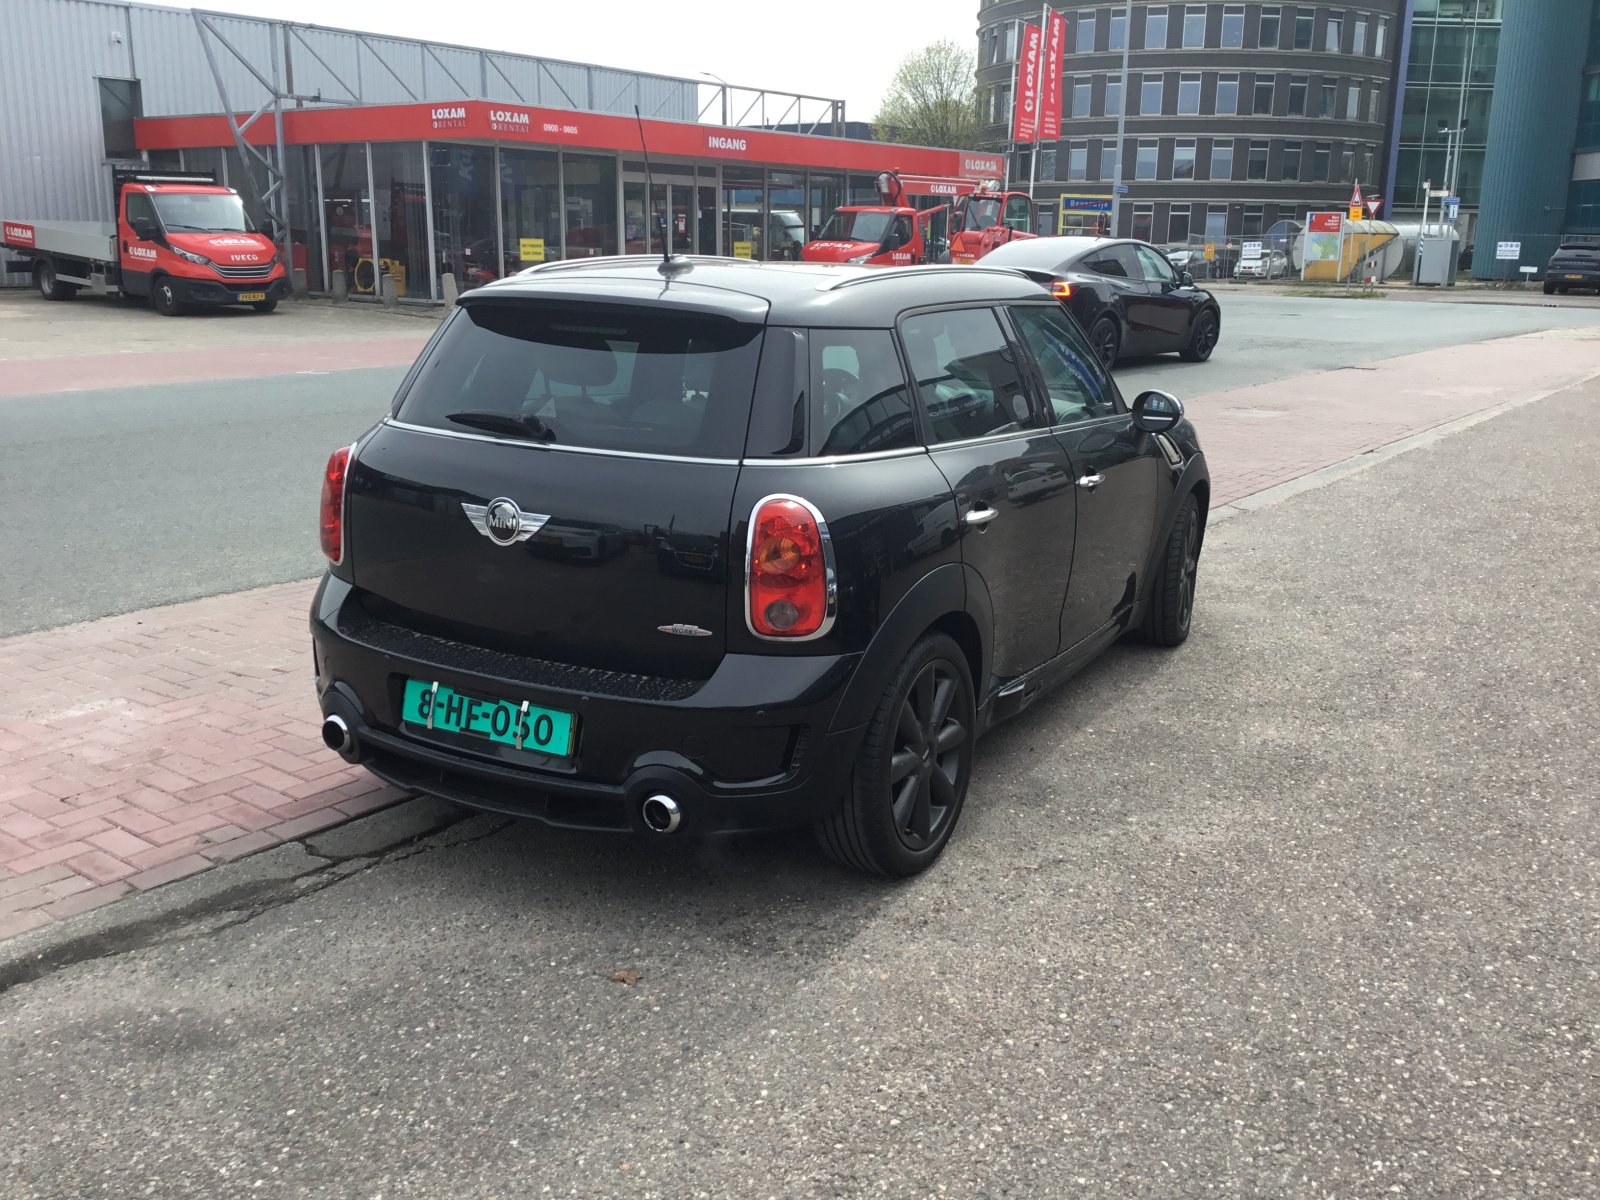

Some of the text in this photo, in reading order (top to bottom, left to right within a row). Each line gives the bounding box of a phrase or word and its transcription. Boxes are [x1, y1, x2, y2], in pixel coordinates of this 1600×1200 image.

[1050, 18, 1060, 91] LOXAM
[1025, 33, 1039, 97] LOXAM
[432, 107, 466, 119] LOXAM
[490, 110, 529, 124] LOXAM
[438, 120, 466, 128] RENTAL
[497, 123, 530, 133] RENTAL
[708, 136, 747, 151] INGANG
[971, 160, 997, 171] LOXAM
[935, 185, 957, 194] LOXAM
[10, 226, 33, 239] LOXAM
[134, 247, 157, 259] LOXAM
[892, 252, 911, 260] LOXAM
[489, 514, 516, 530] MINI
[418, 688, 554, 746] 8-HF-050
